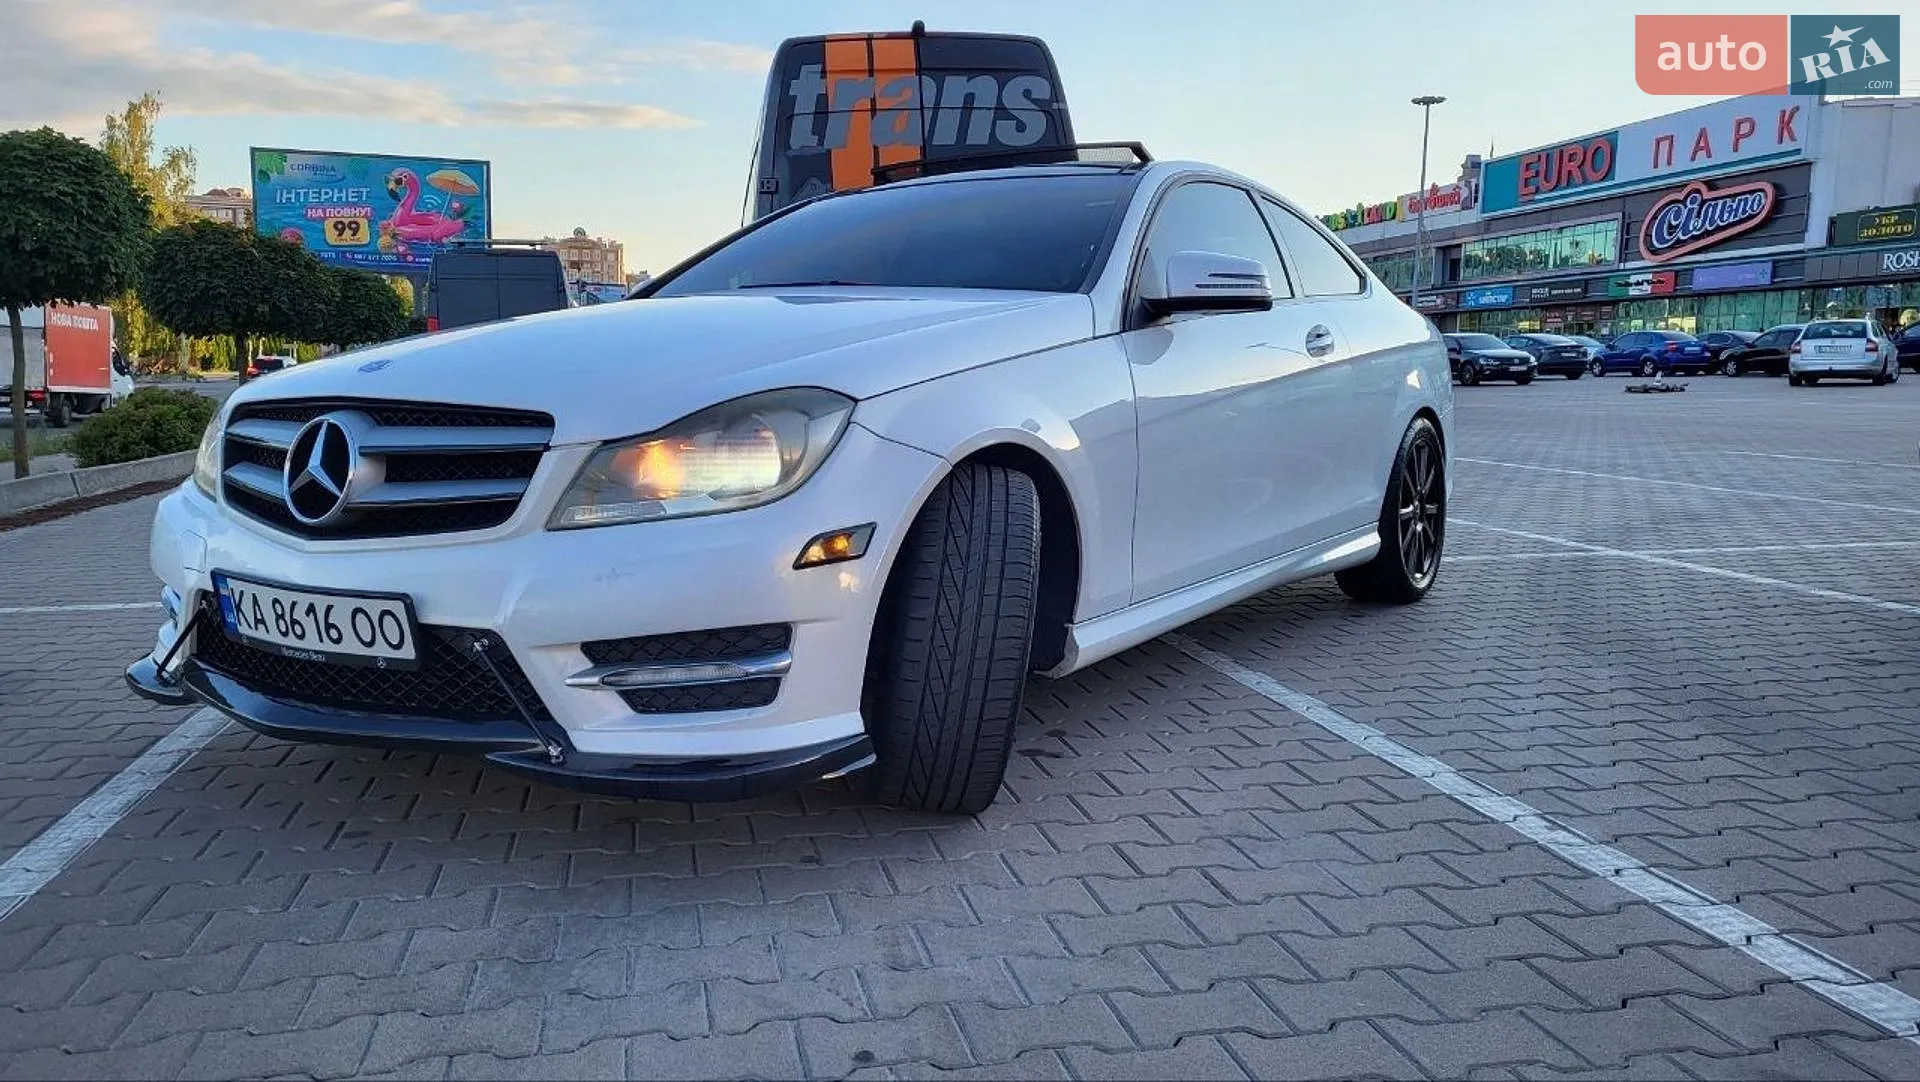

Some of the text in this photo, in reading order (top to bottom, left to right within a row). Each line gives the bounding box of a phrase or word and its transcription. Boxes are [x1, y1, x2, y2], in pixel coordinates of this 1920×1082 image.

[788, 64, 1051, 150] trans
[1518, 139, 1613, 198] EURO
[1652, 105, 1800, 169] ПАРК
[275, 187, 370, 203] ІНТЕРНЕТ
[307, 207, 371, 218] НА ПОВНУ!
[1651, 192, 1766, 249] Сільпо
[333, 220, 360, 237] 99
[1860, 224, 1913, 237] ЗОЛОТО
[51, 311, 99, 331] НОВА ПОШТА
[230, 588, 269, 634] KA
[272, 597, 343, 645] 8616
